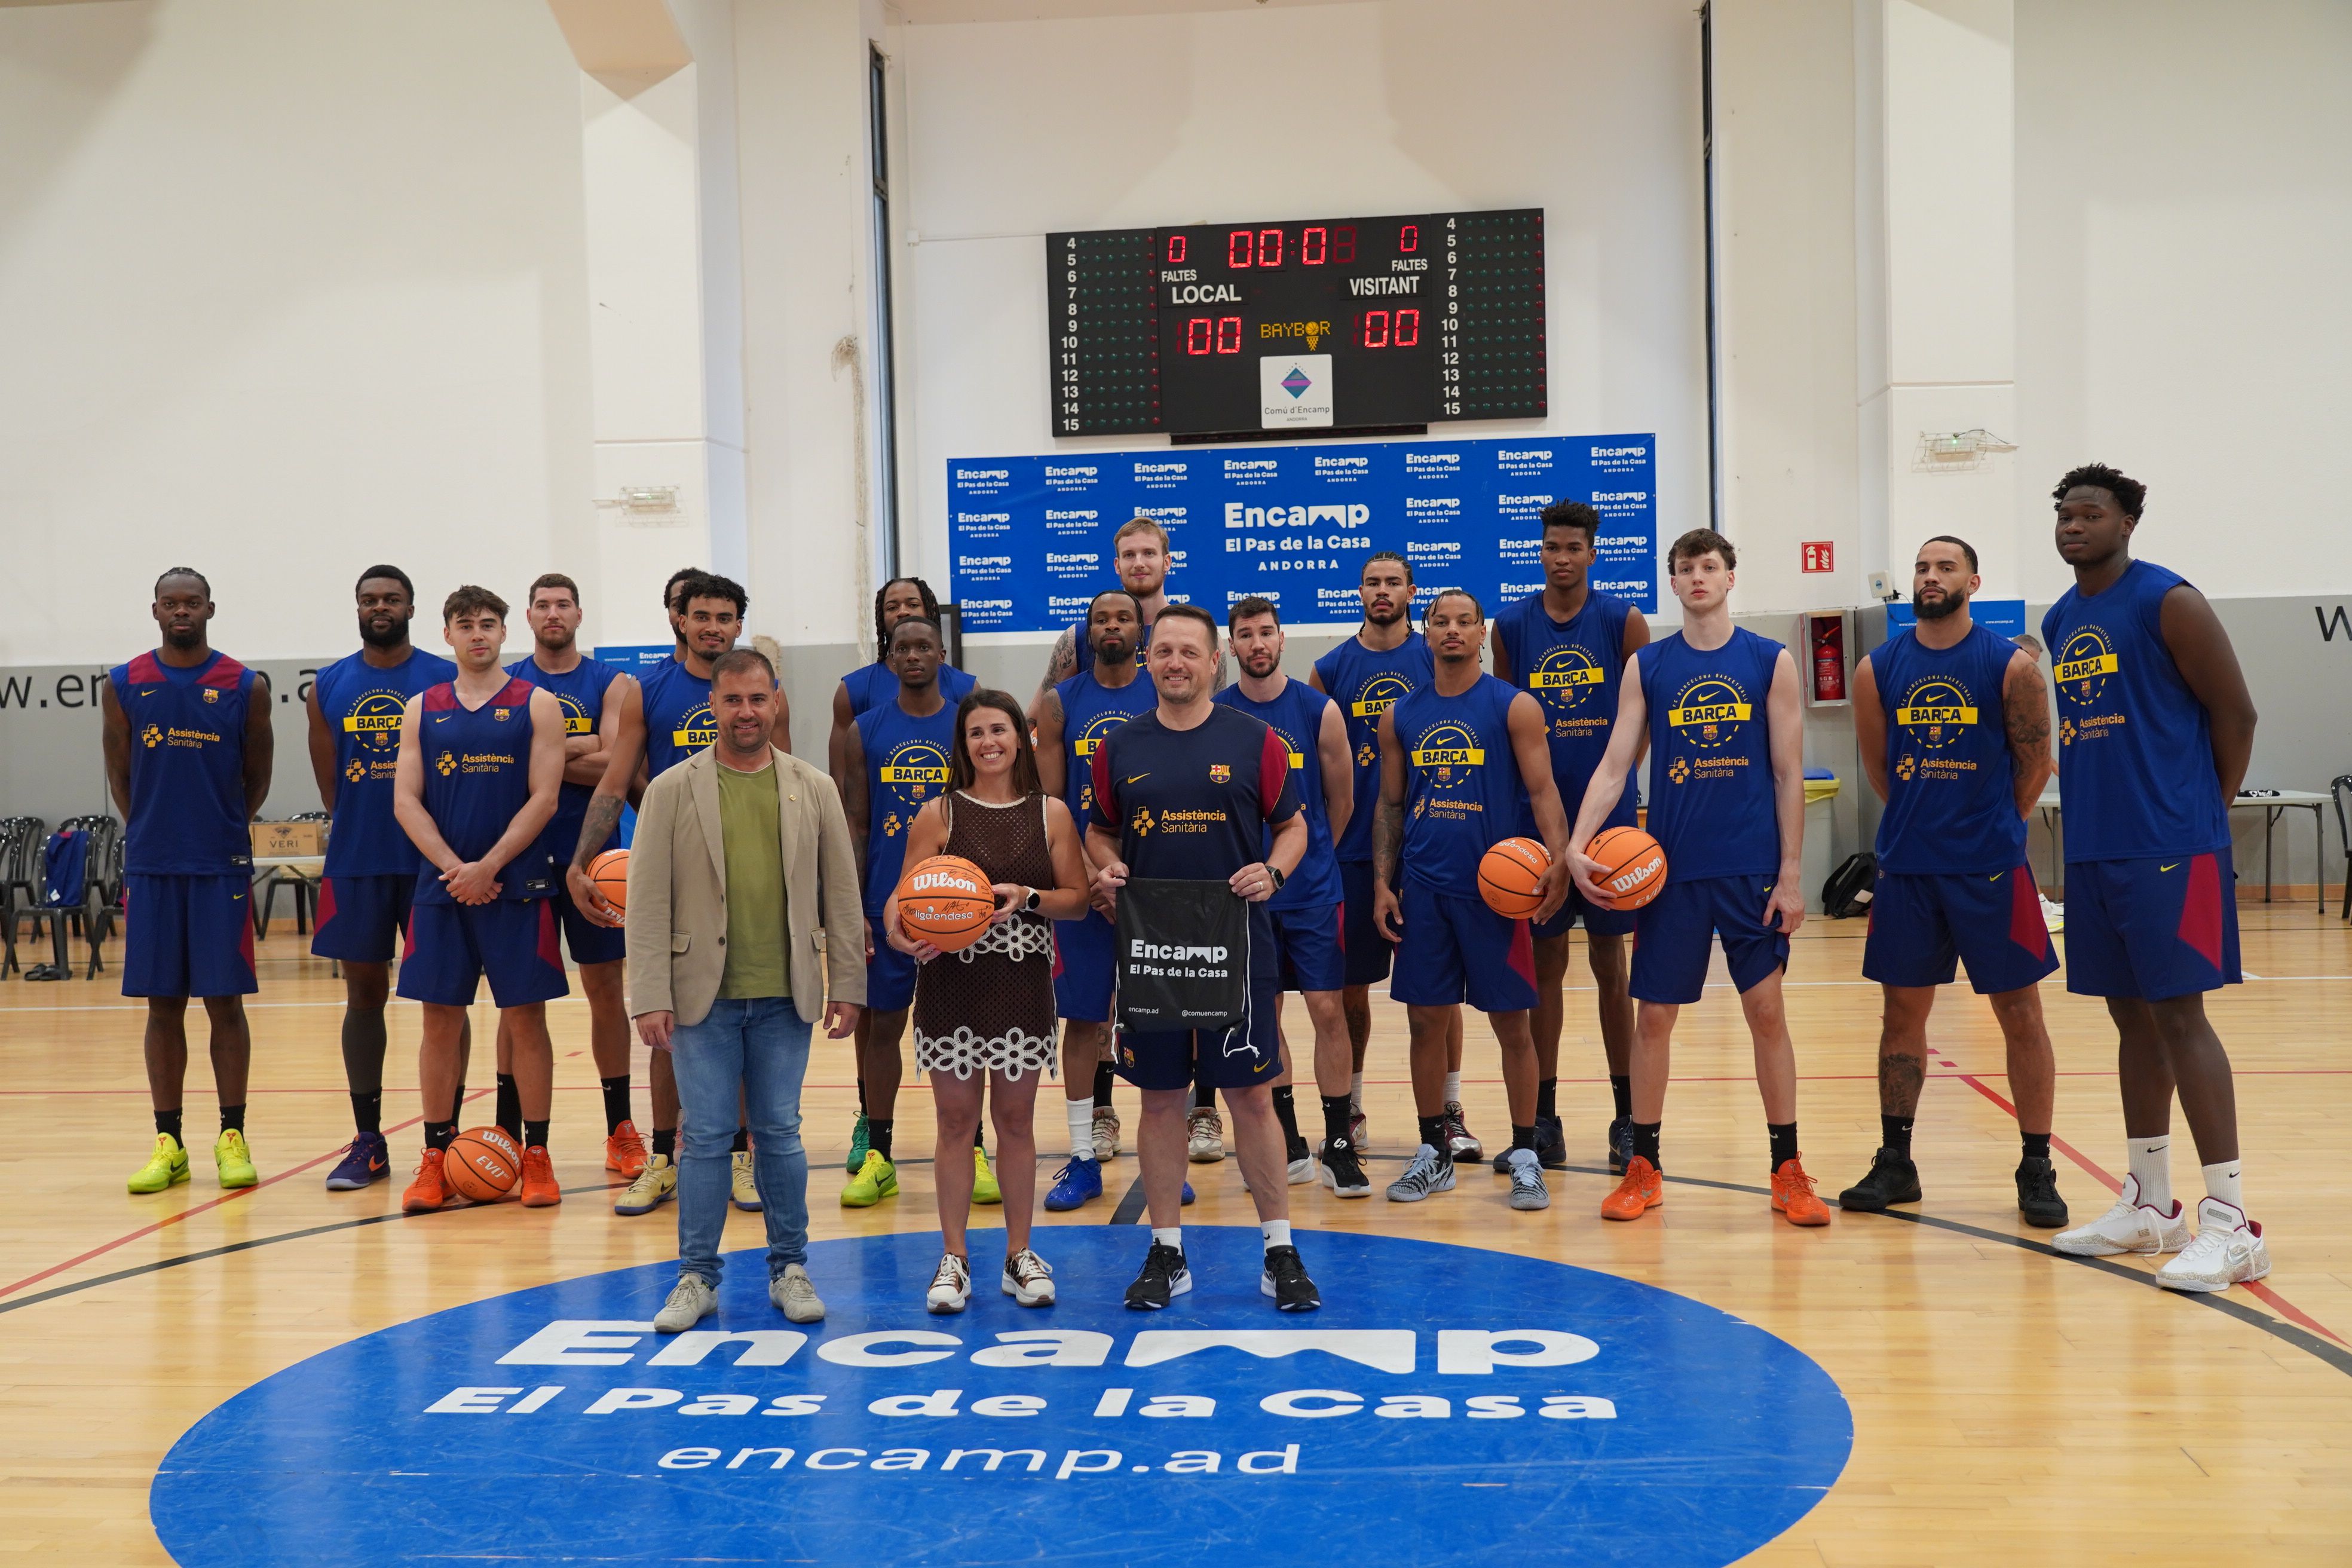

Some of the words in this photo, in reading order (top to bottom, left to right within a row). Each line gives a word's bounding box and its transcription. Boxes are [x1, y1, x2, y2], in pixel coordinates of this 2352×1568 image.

[1446, 218, 1456, 230] 4
[1067, 237, 1076, 249] 4
[1400, 226, 1417, 252] 0
[1447, 234, 1456, 247] 5
[1169, 236, 1186, 262] 0
[1067, 253, 1077, 266] 5
[1447, 251, 1457, 264] 6
[1392, 259, 1428, 271] FALTES
[1067, 270, 1077, 283] 6
[1162, 270, 1197, 282] FALTES
[1447, 268, 1457, 281] 7
[1350, 276, 1419, 295] VISITANT
[1448, 284, 1457, 298] 8
[1067, 287, 1077, 299] 7
[1172, 284, 1241, 304] LOCAL
[1068, 303, 1077, 316] 8
[1448, 301, 1458, 314] 9
[1068, 320, 1077, 332] 9
[1441, 318, 1459, 331] 10
[1061, 336, 1078, 348] 10
[1441, 335, 1457, 348] 11
[1061, 353, 1076, 365] 11
[1442, 352, 1459, 365] 12
[1061, 369, 1079, 382] 12
[1443, 368, 1460, 381] 13
[1062, 385, 1079, 398] 13
[1443, 385, 1460, 398] 14
[1062, 402, 1079, 415] 14
[1264, 406, 1288, 415] Comú
[1443, 402, 1460, 415] 15
[1062, 418, 1079, 431] 15
[1591, 447, 1646, 457] Encamp
[1224, 460, 1277, 470] Encamp
[957, 470, 1009, 479] Encamp
[1407, 498, 1460, 507] Encamp
[1225, 503, 1370, 528] Encamp
[1226, 538, 1241, 552] El
[1246, 538, 1275, 551] Pas
[1280, 537, 1303, 550] de
[1308, 535, 1323, 549] la
[1327, 535, 1370, 549] Casa
[1047, 553, 1098, 563] Encamp
[1258, 560, 1339, 571] ANDORRA
[2062, 659, 2103, 678] BARÇA
[1542, 670, 1590, 685] BARÇA
[1677, 673, 1711, 696] BARCELONA
[1715, 673, 1748, 702] BASKETBALL
[1683, 706, 1737, 721] BARÇA
[1911, 708, 1962, 723] BARÇA
[1555, 717, 1607, 727] Assistència
[2080, 713, 2126, 728] Assistència
[168, 727, 220, 742] Assistència
[688, 731, 718, 743] BAR
[1555, 727, 1592, 737] Sanitària
[2080, 727, 2109, 741] Sanitària
[168, 736, 203, 748] Sanitària
[462, 753, 514, 764] Assistència
[1422, 751, 1469, 764] BARÇA
[1693, 756, 1748, 767] Assistència
[370, 761, 397, 770] Assist
[462, 764, 500, 773] Sanitària
[370, 769, 396, 779] Sanità
[893, 768, 944, 782] BARÇA
[1694, 767, 1734, 779] Sanitària
[1920, 768, 1958, 779] Snitària
[1429, 798, 1483, 812] Assistència
[1161, 810, 1226, 821] Assistència
[1429, 808, 1465, 820] Sanitària
[1162, 821, 1207, 832] Sanitària
[270, 840, 298, 848] VERI
[1611, 856, 1662, 892] Wilson
[913, 872, 977, 893] Wilson
[915, 909, 932, 920] liga
[933, 911, 973, 920] endesa
[1131, 939, 1227, 963] Encamp
[1130, 964, 1140, 974] El
[1143, 965, 1164, 976] Pas
[1168, 967, 1181, 976] de
[1185, 967, 1195, 977] la
[1198, 968, 1227, 977] Casa
[482, 1131, 520, 1169] Wilson
[494, 1320, 1600, 1374] Encamp
[423, 1386, 566, 1414] El
[583, 1388, 828, 1416] Pas
[868, 1389, 1047, 1417] de
[1093, 1388, 1217, 1417] la
[1259, 1389, 1617, 1419] Casa
[657, 1444, 1300, 1480] encamp.ad
